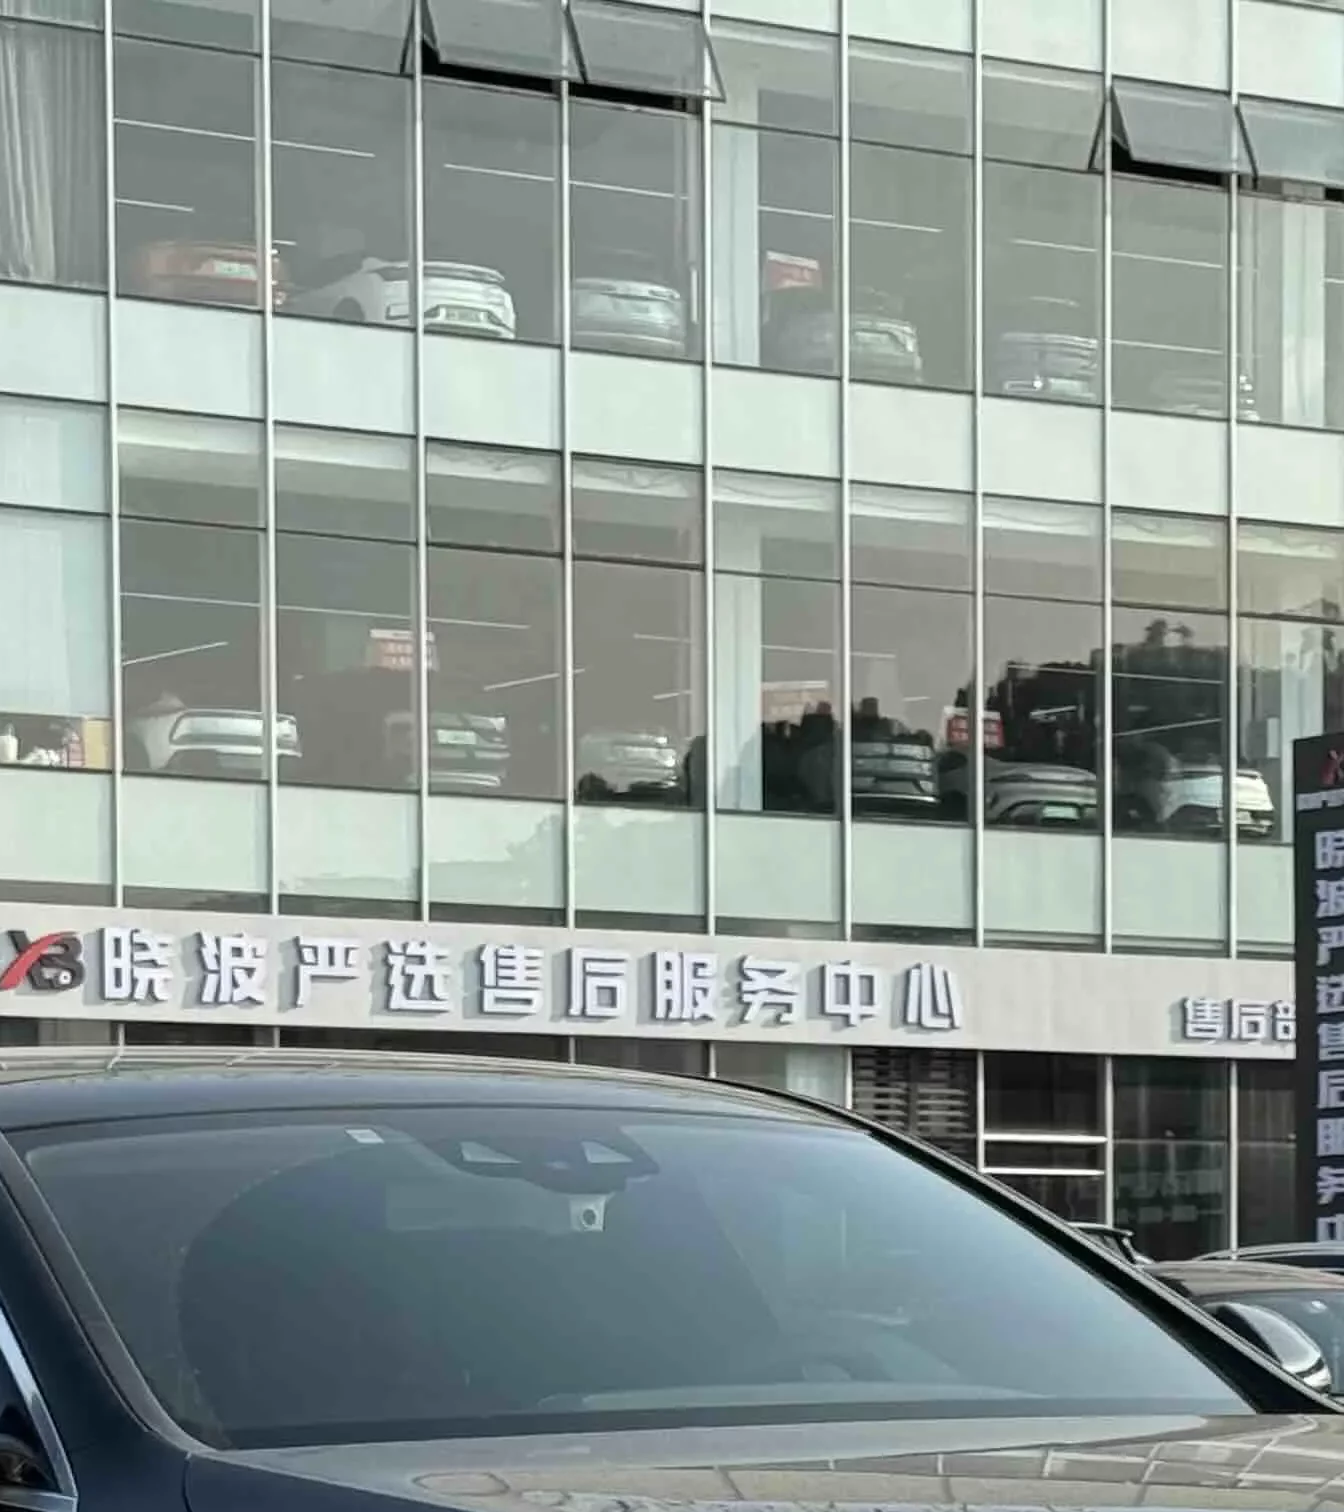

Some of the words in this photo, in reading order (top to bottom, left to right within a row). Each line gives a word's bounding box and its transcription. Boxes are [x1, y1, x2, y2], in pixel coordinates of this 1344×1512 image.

[98, 927, 962, 1031] 晓波严选售后服务中心
